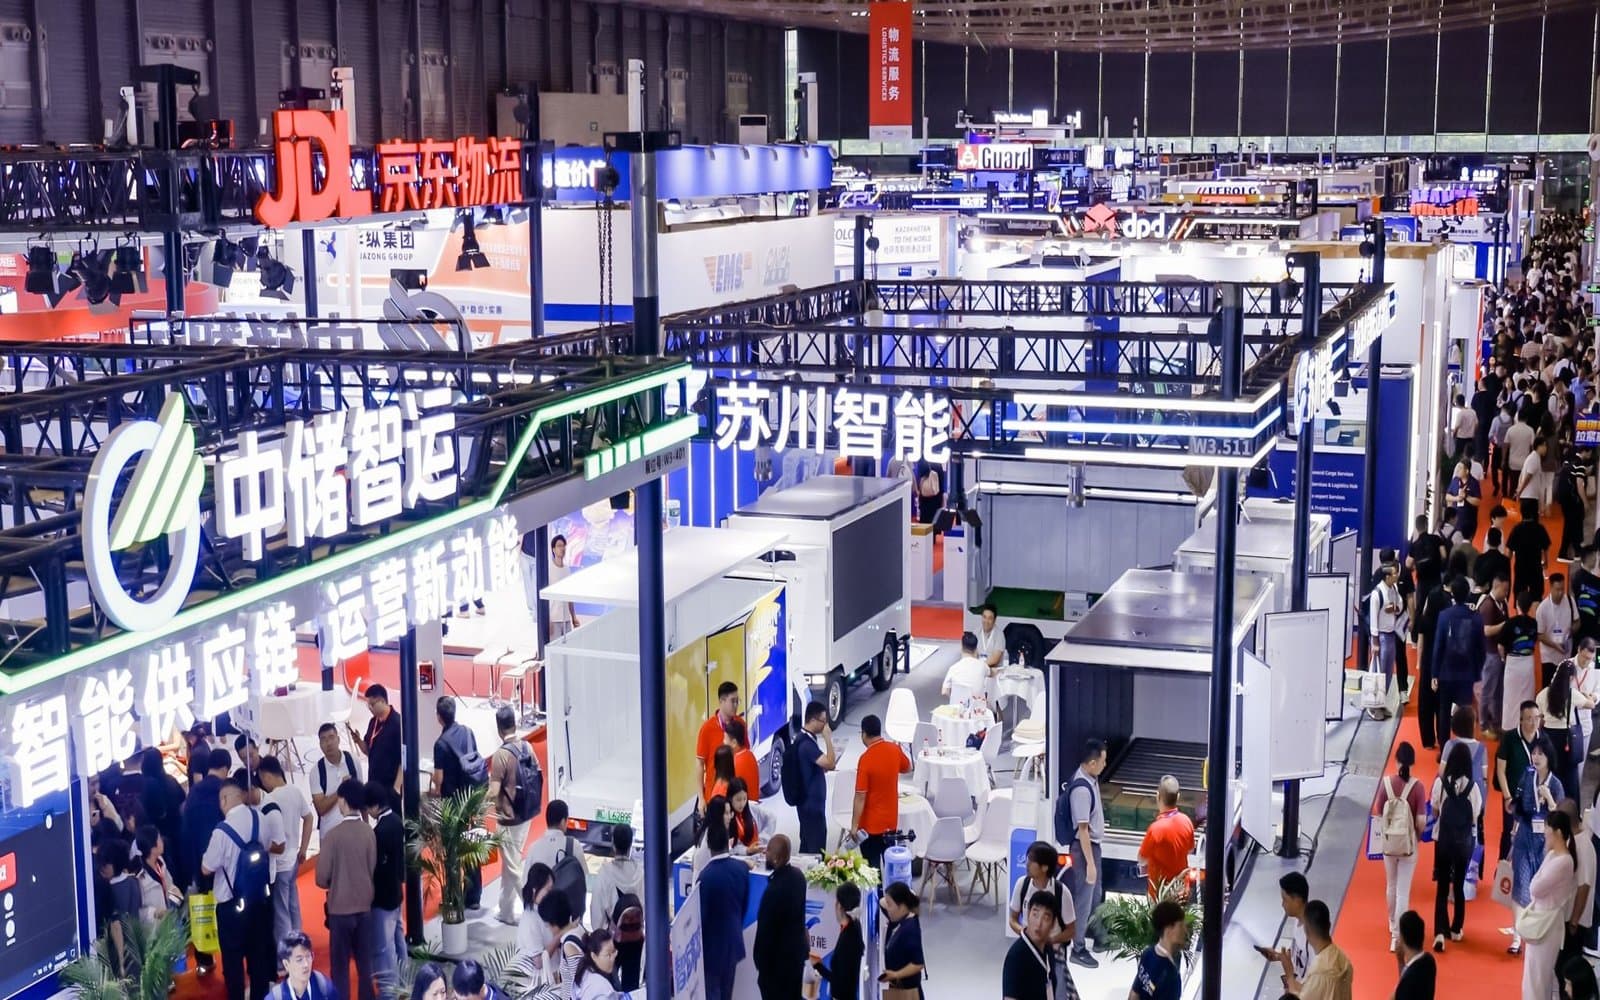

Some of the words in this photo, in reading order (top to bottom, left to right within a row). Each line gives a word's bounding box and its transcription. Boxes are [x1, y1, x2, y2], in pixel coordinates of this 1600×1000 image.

[888, 27, 899, 101] 物流服务
[255, 110, 372, 227] JDL
[377, 136, 522, 212] 京东物流
[982, 147, 1031, 169] Guard
[360, 231, 414, 249] 纵集团
[388, 252, 413, 261] GROUP
[1123, 212, 1165, 240] dpd
[715, 382, 952, 465] 苏川智能
[1192, 438, 1251, 456] W3.511
[216, 388, 458, 561] 中储智运
[9, 602, 299, 808] 智能供应链
[326, 513, 520, 667] 运营新动能
